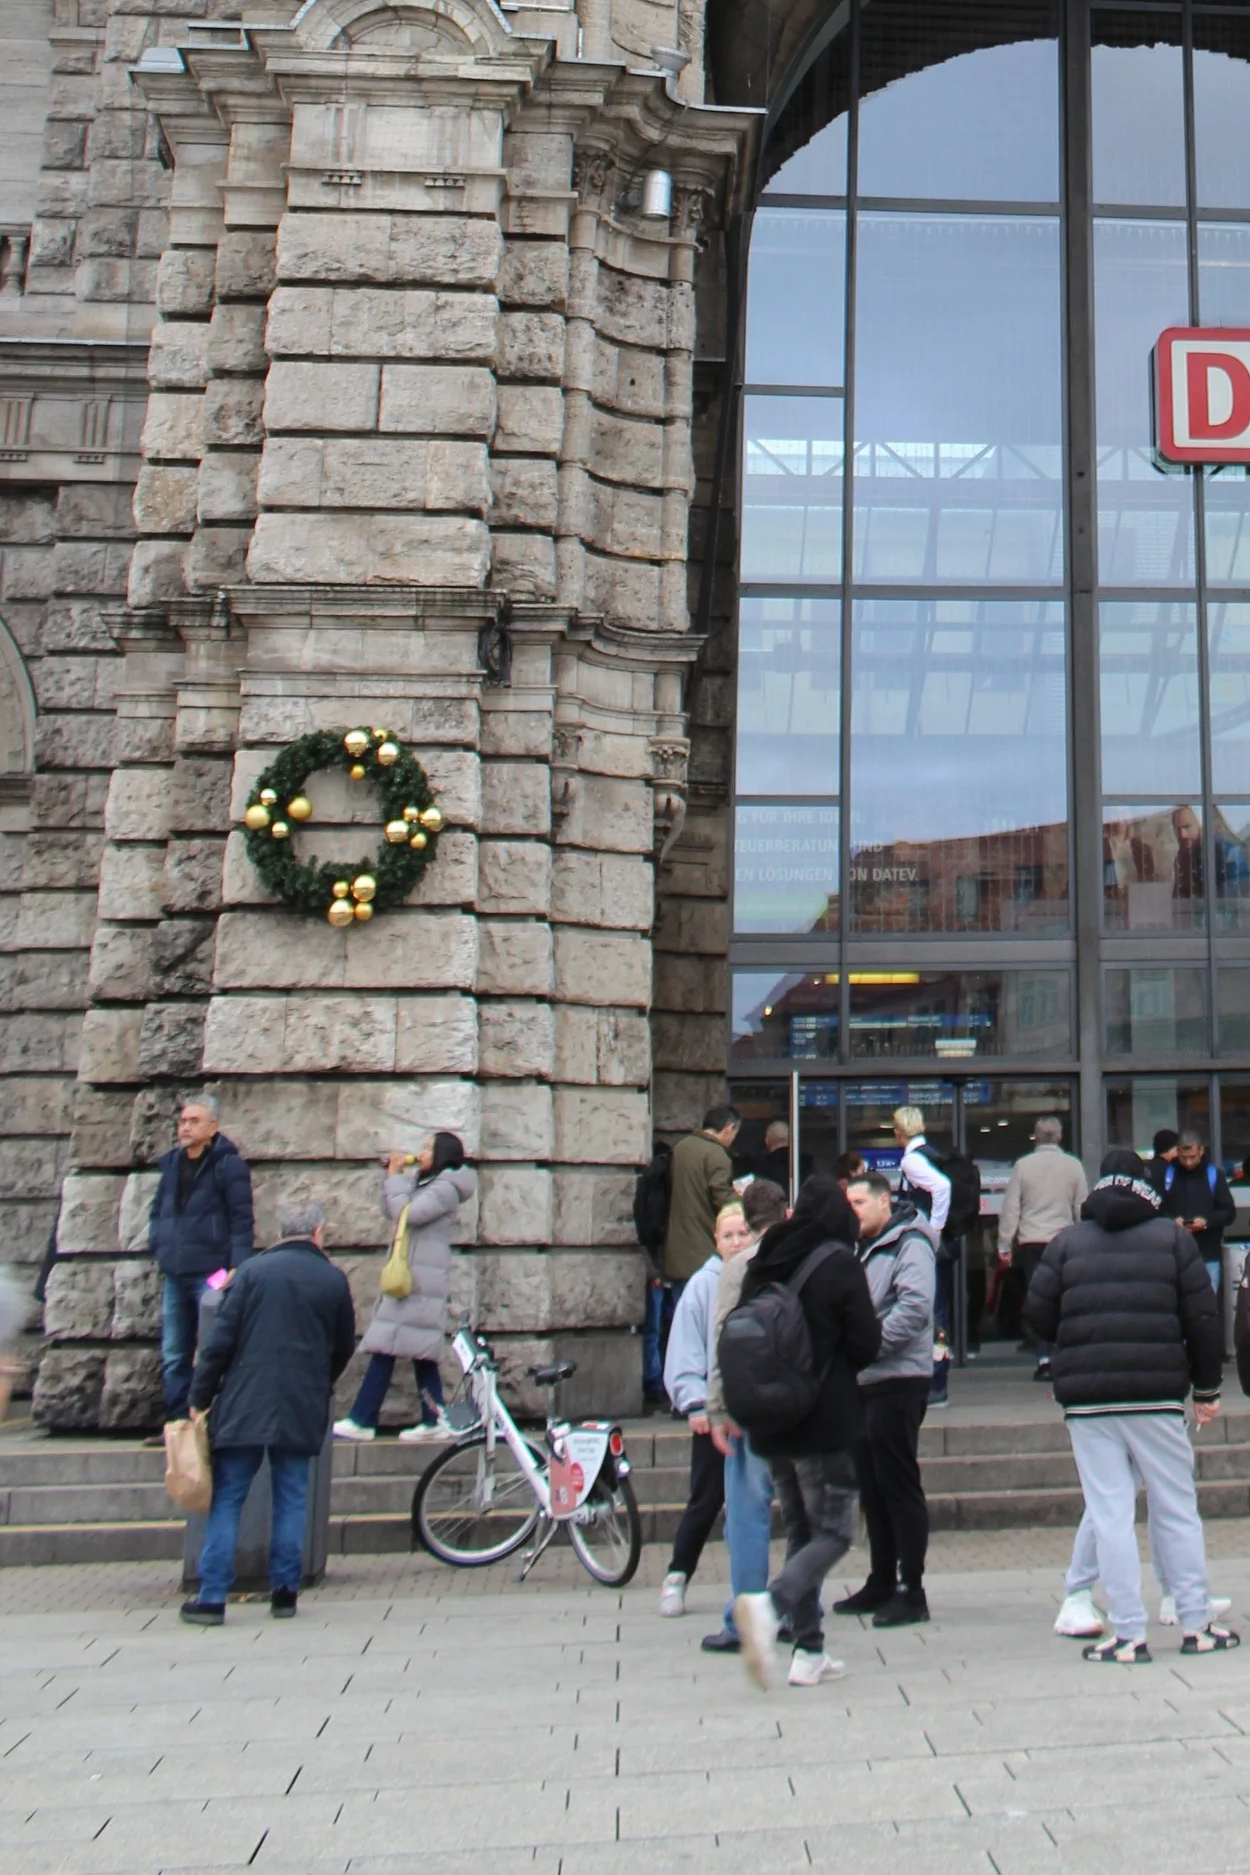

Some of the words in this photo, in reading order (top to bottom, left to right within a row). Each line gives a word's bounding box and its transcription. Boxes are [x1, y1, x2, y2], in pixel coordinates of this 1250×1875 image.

[752, 809, 778, 824] FÜR
[783, 810, 814, 824] IHRE
[734, 838, 839, 853] TEUERBERATUN
[735, 868, 753, 882] EN
[759, 866, 833, 882] LÖSUNGEN
[849, 868, 867, 882] ON
[873, 868, 919, 882] DATEV.
